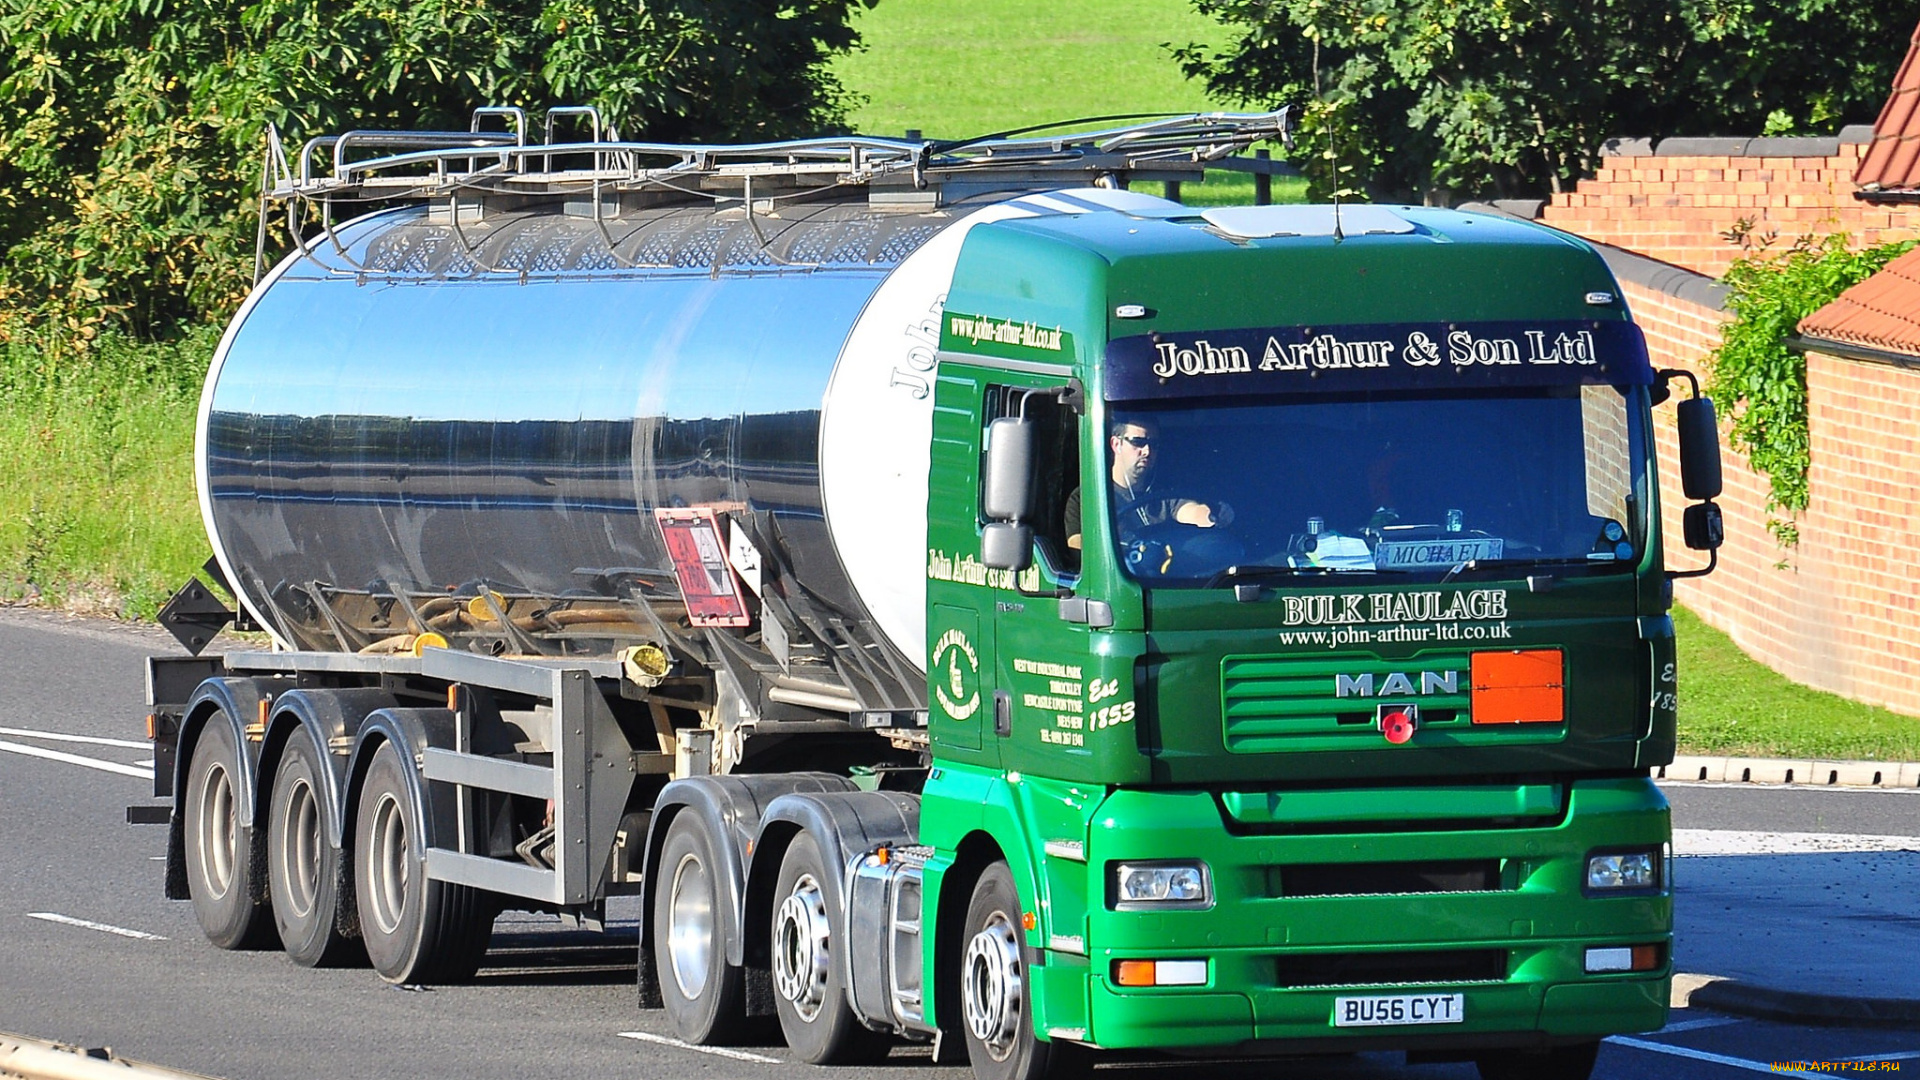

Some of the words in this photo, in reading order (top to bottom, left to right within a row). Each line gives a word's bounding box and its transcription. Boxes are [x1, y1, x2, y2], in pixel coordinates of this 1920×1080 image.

[951, 314, 1063, 350] www.john-arthur-ltd.co.uk
[1153, 340, 1251, 379] John
[1258, 335, 1394, 371] Arthur
[1403, 331, 1441, 367] &
[1449, 330, 1523, 366] Son
[1526, 331, 1597, 365] Ltd
[928, 548, 952, 581] John
[953, 552, 988, 586] Arthur
[1392, 543, 1484, 564] MICHAEL
[1282, 594, 1365, 625] BULK
[1368, 590, 1508, 623] HAULAGE
[1280, 622, 1512, 648] www.john-arthur-ltd.co.uk
[1089, 678, 1119, 703] Est
[1335, 670, 1458, 698] MAN
[1654, 691, 1677, 713] 185
[1089, 701, 1136, 732] 1853
[1345, 999, 1404, 1022] BU56
[1411, 997, 1455, 1020] CYT
